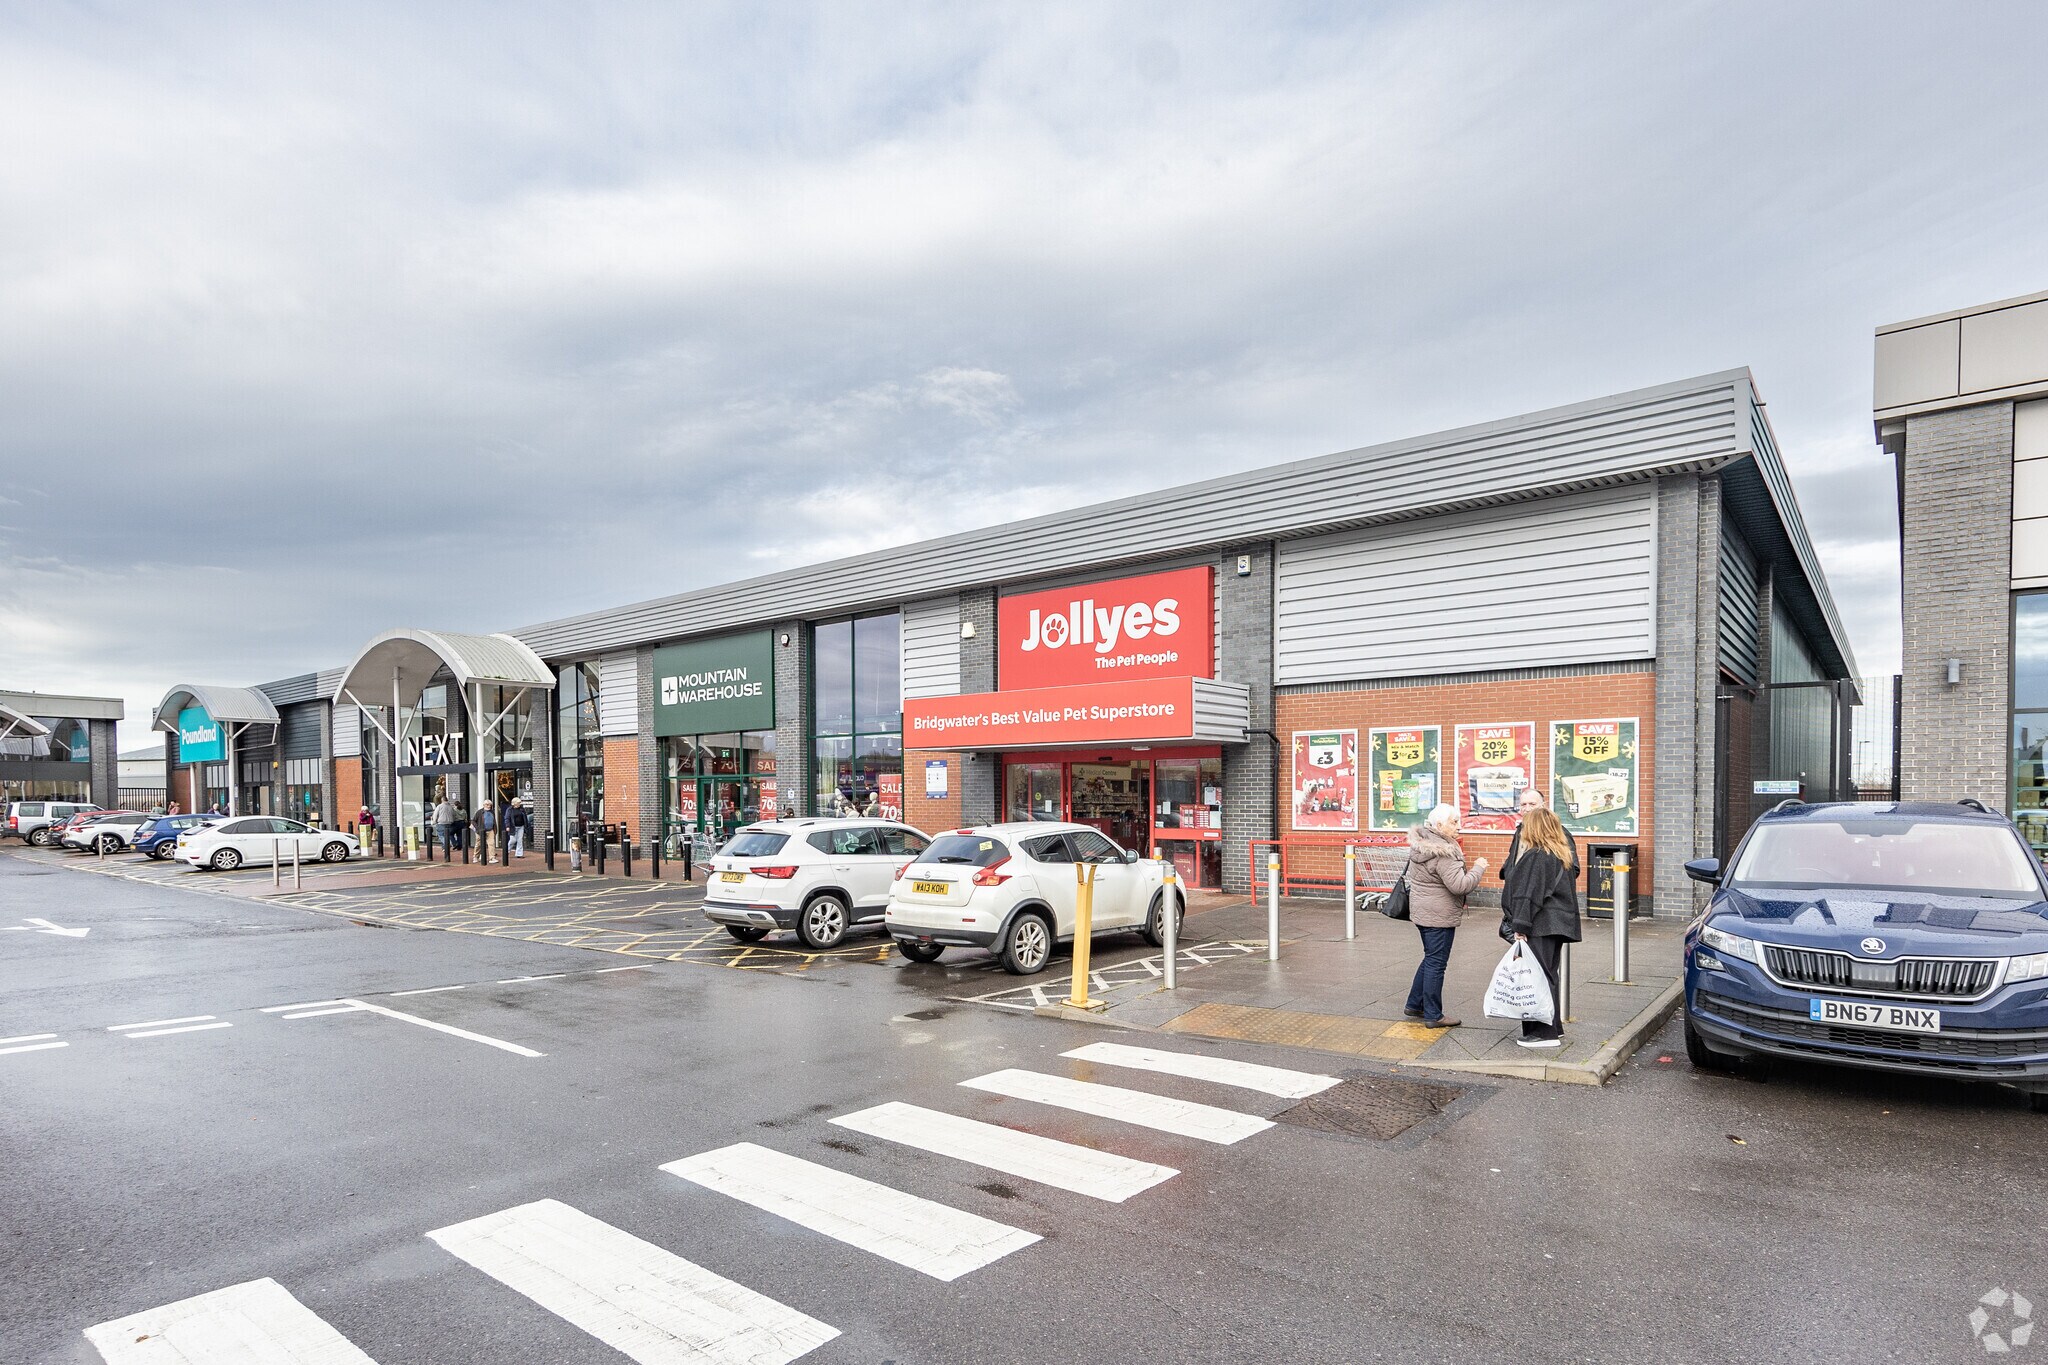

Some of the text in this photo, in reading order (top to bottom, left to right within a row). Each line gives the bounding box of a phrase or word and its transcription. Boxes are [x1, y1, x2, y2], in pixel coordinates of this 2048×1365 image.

[1020, 598, 1181, 653] Jollyes
[1095, 651, 1178, 669] The Pet People
[678, 667, 747, 688] MOUNTAIN
[678, 682, 762, 704] WAREHOUSE
[913, 702, 1175, 731] Bridgwater's Best Value Pet Superstore
[181, 723, 217, 745] Poundland
[1478, 728, 1511, 739] SAVE
[1578, 724, 1615, 735] SAVE
[1482, 741, 1508, 750] 20%
[1583, 736, 1609, 746] 15%
[407, 732, 464, 767] NEXT
[1392, 751, 1399, 760] 3
[1408, 750, 1420, 760] £3
[1482, 750, 1508, 760] OFF
[1582, 746, 1609, 755] OFF
[1317, 752, 1334, 764] £3
[757, 761, 776, 770] SAL
[881, 783, 902, 794] SALE
[1825, 1002, 1935, 1028] BN67 BNX
